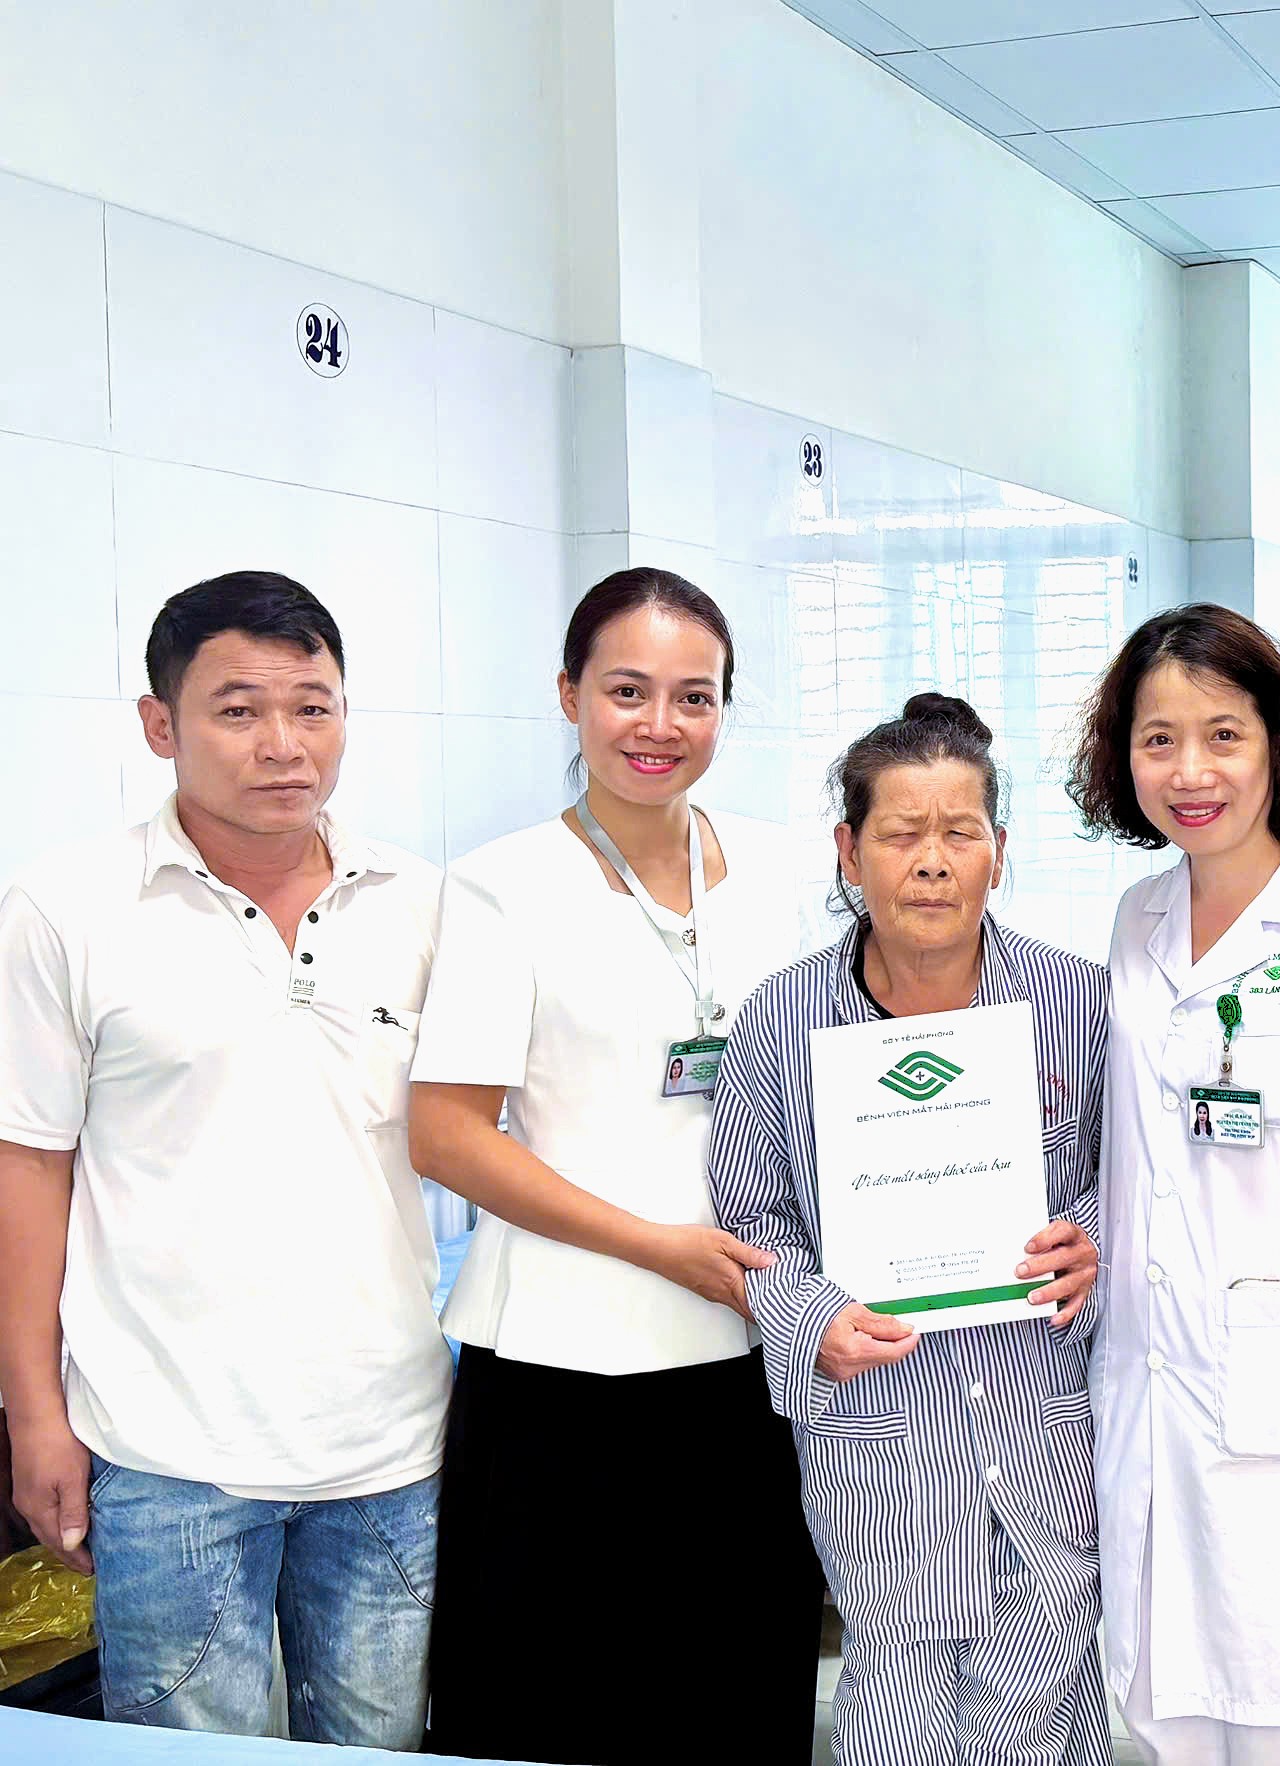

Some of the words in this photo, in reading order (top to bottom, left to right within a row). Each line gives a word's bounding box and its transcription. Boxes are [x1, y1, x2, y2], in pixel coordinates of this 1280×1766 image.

[305, 313, 342, 368] 24
[804, 441, 822, 478] 23
[936, 1102, 952, 1112] HẢI
[954, 1098, 991, 1109] PHÒNG
[915, 1168, 941, 1185] sáng
